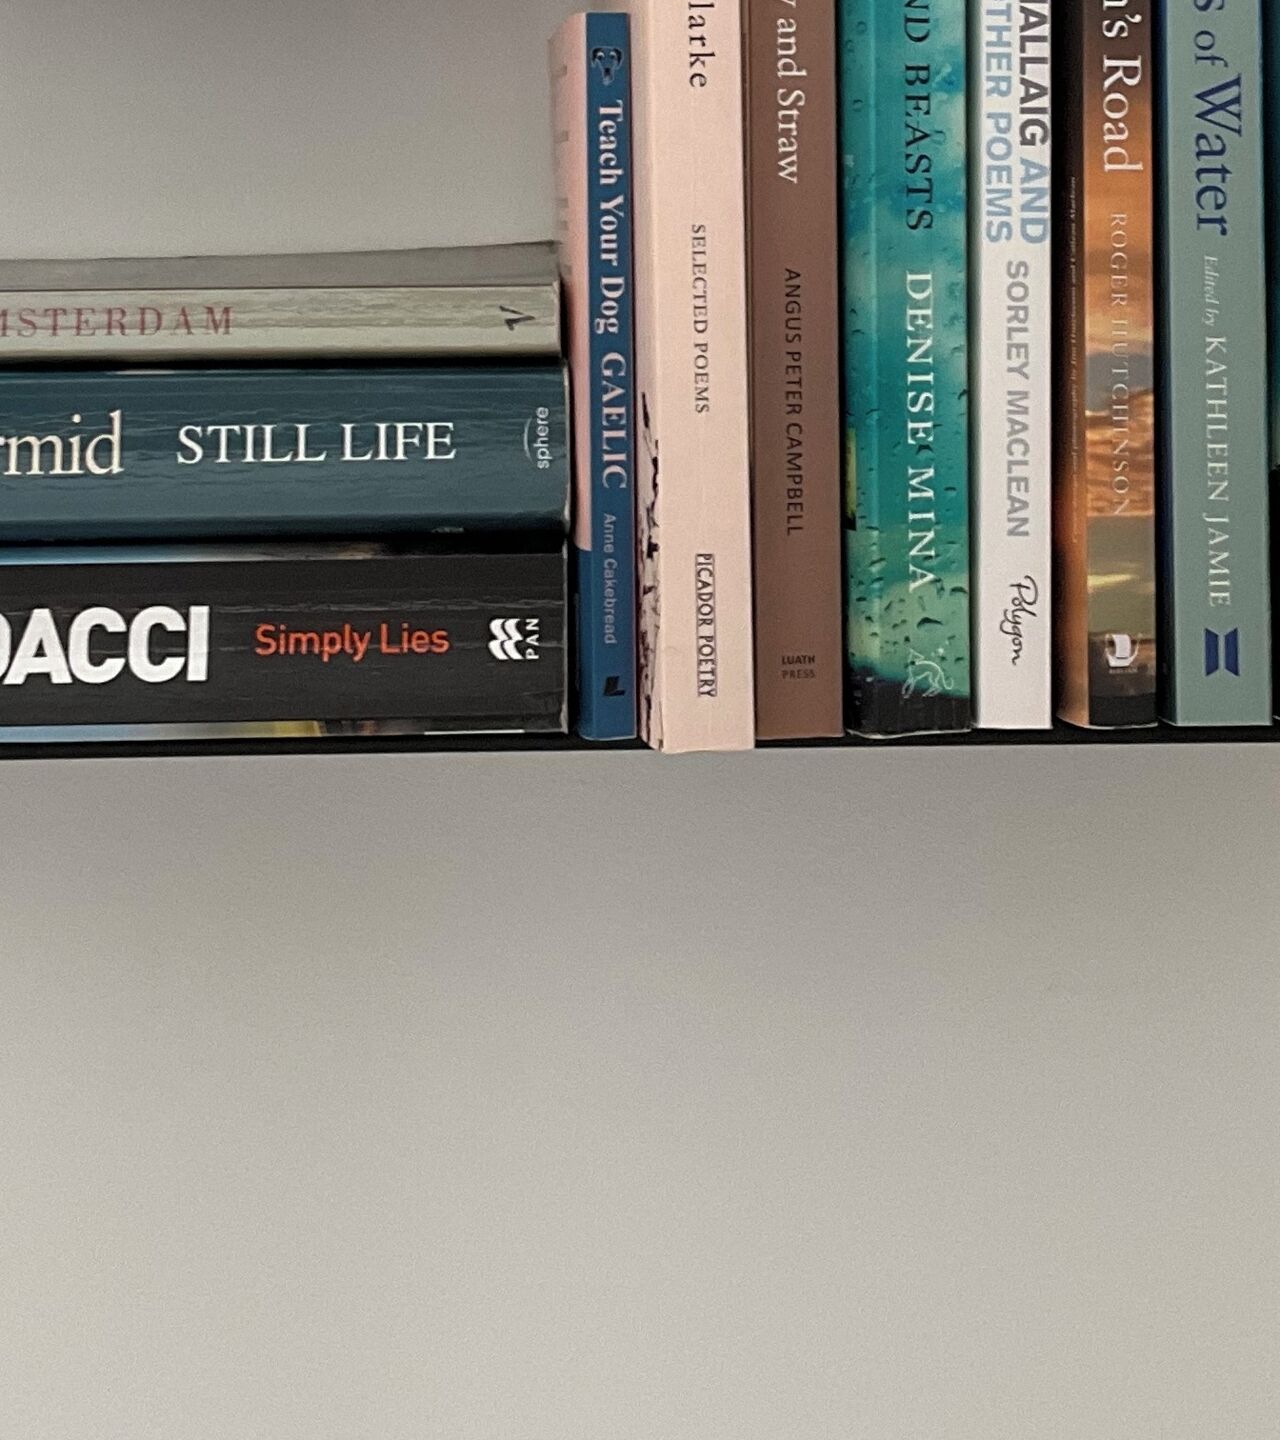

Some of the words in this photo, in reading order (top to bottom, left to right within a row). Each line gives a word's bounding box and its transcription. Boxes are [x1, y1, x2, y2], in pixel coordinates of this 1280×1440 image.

[776, 17, 807, 77] and
[1194, 29, 1229, 69] of
[597, 99, 625, 185] Teach
[776, 87, 806, 184] Straw
[904, 63, 934, 232] BEASTS
[1101, 54, 1144, 173] Road
[1194, 72, 1243, 236] Water
[984, 111, 1013, 244] POEMS
[1019, 155, 1050, 244] AND
[598, 194, 626, 266] Your
[1110, 212, 1129, 306] ROGER
[594, 275, 626, 335] Dog
[691, 224, 709, 335] SELECTED
[785, 267, 803, 343] ANGUS
[1005, 259, 1030, 381] SORLEY
[1201, 307, 1219, 326] by
[1203, 254, 1220, 305] Edited
[693, 343, 710, 415] POEMS
[786, 350, 803, 414] PETER
[905, 270, 935, 446] DENISE
[176, 422, 326, 466] STILL
[339, 421, 457, 462] LIFE
[536, 406, 550, 469] sphere
[600, 351, 628, 489] GAELIC
[1110, 318, 1130, 517] HUTCHINSON
[1205, 335, 1229, 502] KATHLEEN
[786, 422, 805, 537] CAMPBELL
[1005, 389, 1030, 538] MACLEAN
[603, 512, 618, 554] Anne
[907, 465, 936, 595] MINA
[1202, 512, 1231, 607] JAMIE
[603, 557, 618, 645] Cakebread
[696, 552, 715, 628] PICADOR
[999, 574, 1039, 666] Polygon
[253, 622, 371, 663] Simply
[379, 621, 450, 656] Lies
[524, 617, 540, 660] PAN
[698, 635, 716, 698] POETRY
[782, 655, 815, 665] LUATH
[782, 669, 815, 679] PRESS
